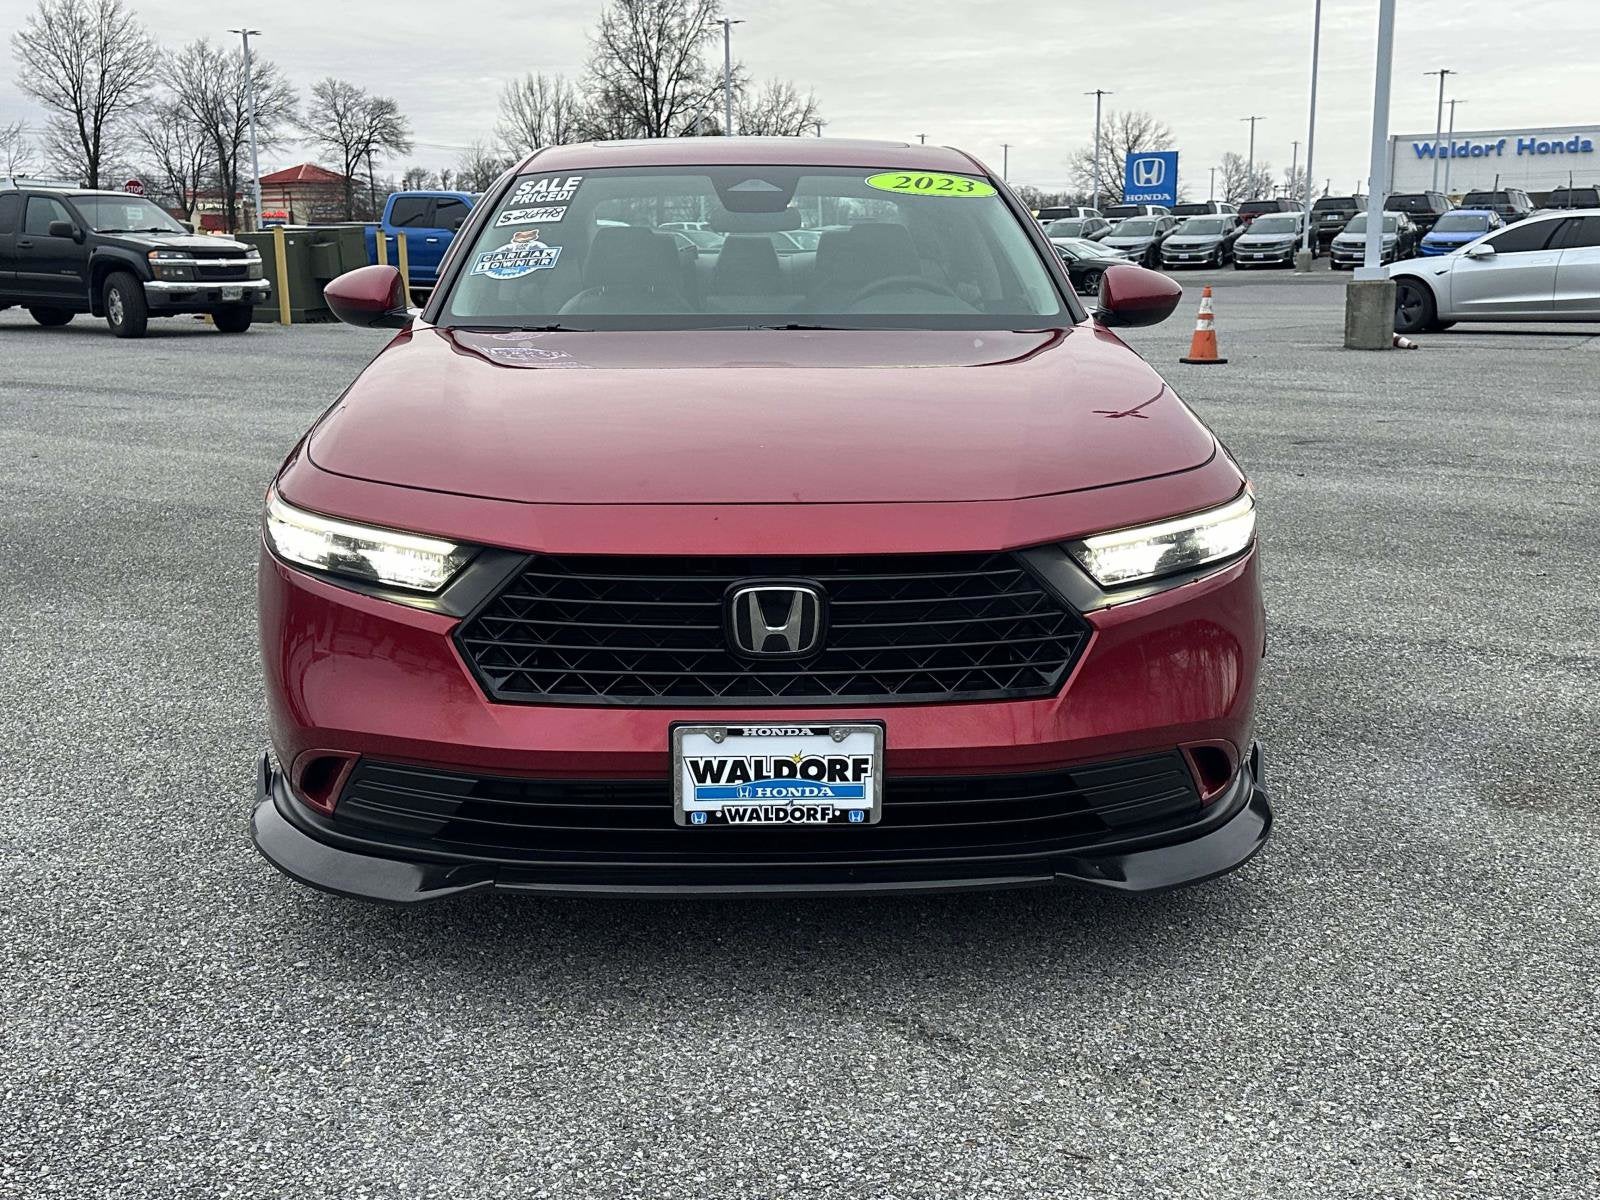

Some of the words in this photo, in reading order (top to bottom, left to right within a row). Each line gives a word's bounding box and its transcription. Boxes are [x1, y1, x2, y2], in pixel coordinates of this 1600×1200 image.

[1413, 139, 1506, 159] Waldorf
[1517, 135, 1594, 155] Honda
[125, 185, 143, 194] STOP
[516, 177, 583, 196] SALE
[892, 176, 975, 192] 2023
[510, 191, 574, 205] PRICED!
[1126, 193, 1171, 202] HONDA
[481, 250, 554, 262] CARFAX
[490, 258, 552, 269] OWNER
[743, 727, 814, 736] HONDA
[687, 756, 870, 785] WALDORF
[756, 786, 835, 797] HONDA
[726, 806, 832, 823] WALDORF
